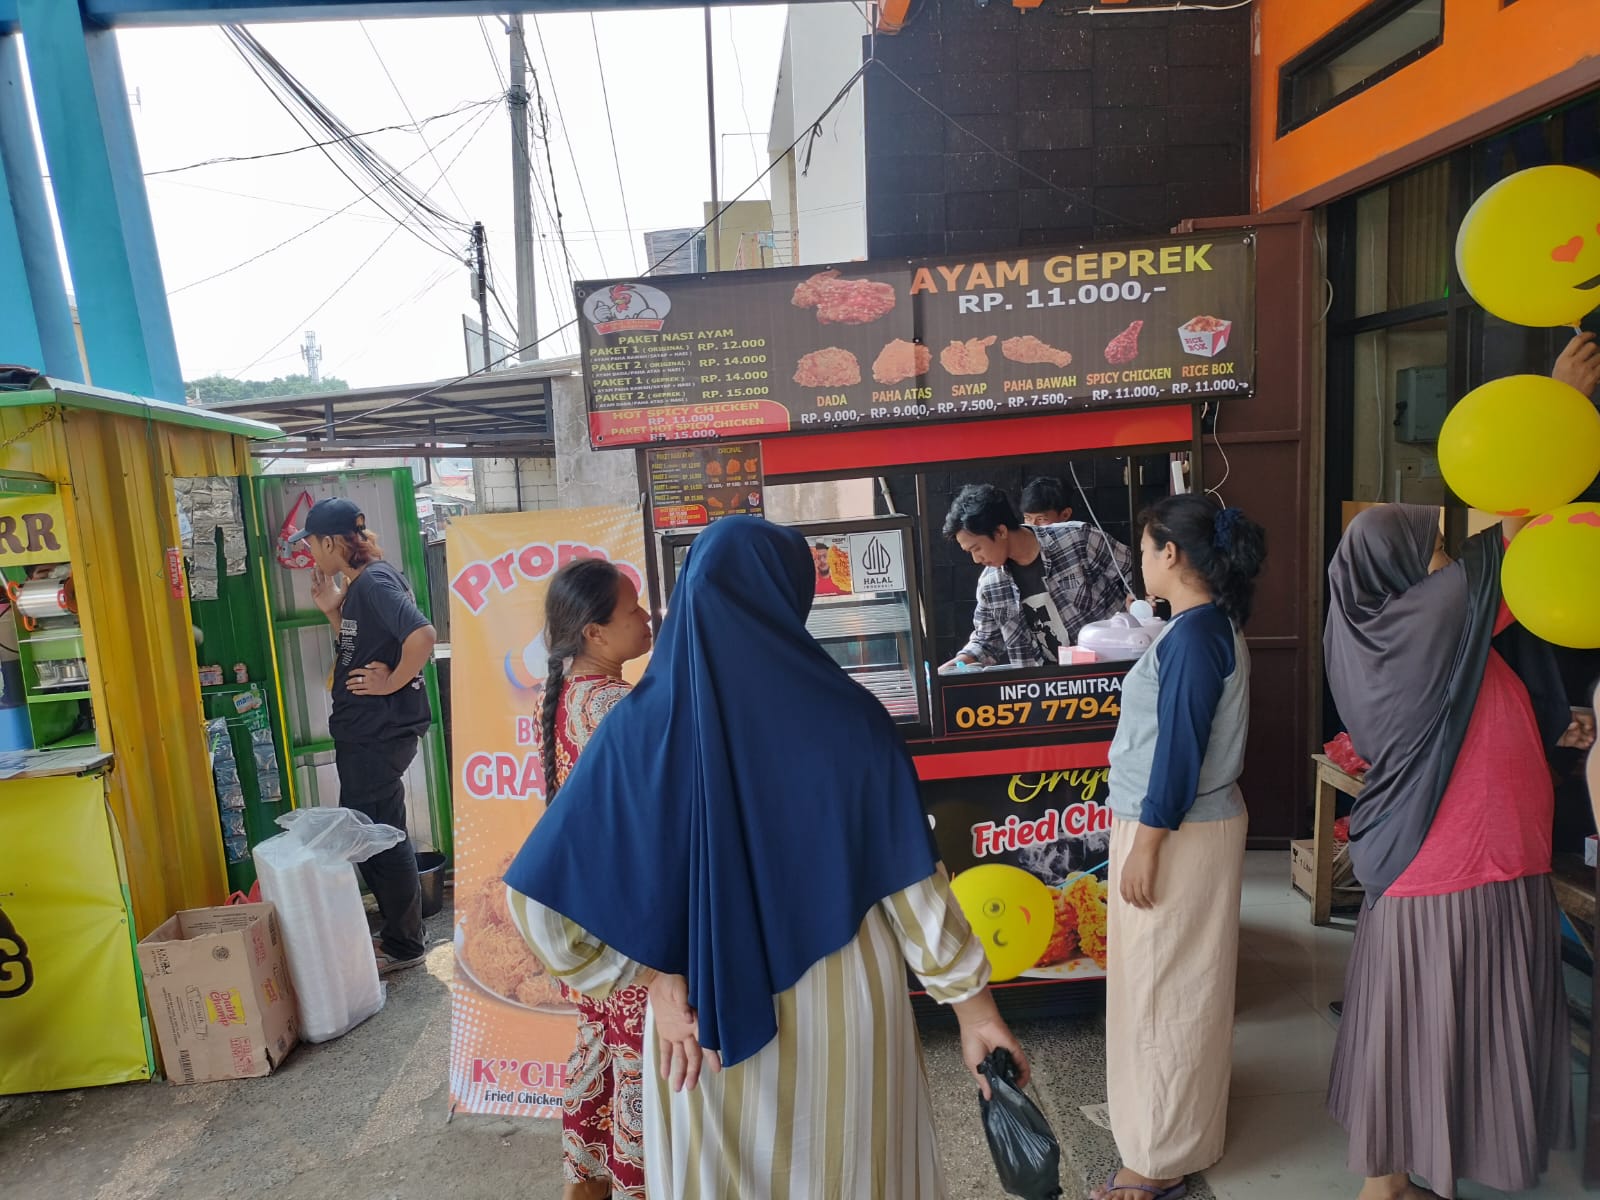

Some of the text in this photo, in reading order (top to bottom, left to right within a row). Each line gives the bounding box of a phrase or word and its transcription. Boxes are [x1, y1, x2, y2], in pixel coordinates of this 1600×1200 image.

[909, 244, 1213, 295] AYAM GEPREK
[959, 281, 1167, 314] RP. 11.000,-
[618, 329, 734, 345] PAKET NASI AYAM
[590, 347, 627, 357] PAKET
[698, 342, 719, 352] RP.
[723, 339, 766, 349] 12.000
[592, 362, 630, 372] PAKET
[634, 361, 642, 369] 2
[699, 359, 720, 367] RP.
[724, 354, 767, 365] 14.000
[1182, 362, 1235, 378] RICE BOX
[593, 378, 632, 387] PAKET
[701, 375, 722, 383] RP.
[725, 370, 768, 381] 14.000
[1004, 375, 1077, 392] PAHA BAWAH
[1086, 368, 1172, 386] SPICY CHICKEN
[595, 392, 634, 402] PAKET
[637, 391, 645, 399] 2
[702, 390, 723, 399] RP.
[727, 386, 769, 397] 15.000
[872, 387, 933, 403] PAHA ATAS
[951, 383, 987, 397] SAYAP
[1092, 385, 1165, 401] RP. 11.000,-
[1171, 383, 1192, 394] RP.
[816, 394, 847, 407] DADA
[938, 399, 1002, 414] RP. 7.500,-
[1008, 393, 1073, 408] RP. 7.500,-
[612, 402, 760, 420] HOT SPICY CHICKEN
[673, 413, 715, 424] 11.000
[801, 410, 865, 425] RP. 9.000,-
[870, 407, 891, 419] RP.
[611, 417, 765, 436] PAKET HOT SPICY CHICKEN
[864, 576, 893, 585] HALAL
[1000, 677, 1122, 701] INFO KEMITRA
[956, 695, 1121, 729] 0857 7794
[972, 811, 1057, 857] Fried
[210, 991, 229, 1027] Champ
[221, 991, 237, 1021] Dairy
[485, 1090, 563, 1106] Fried Chicken
